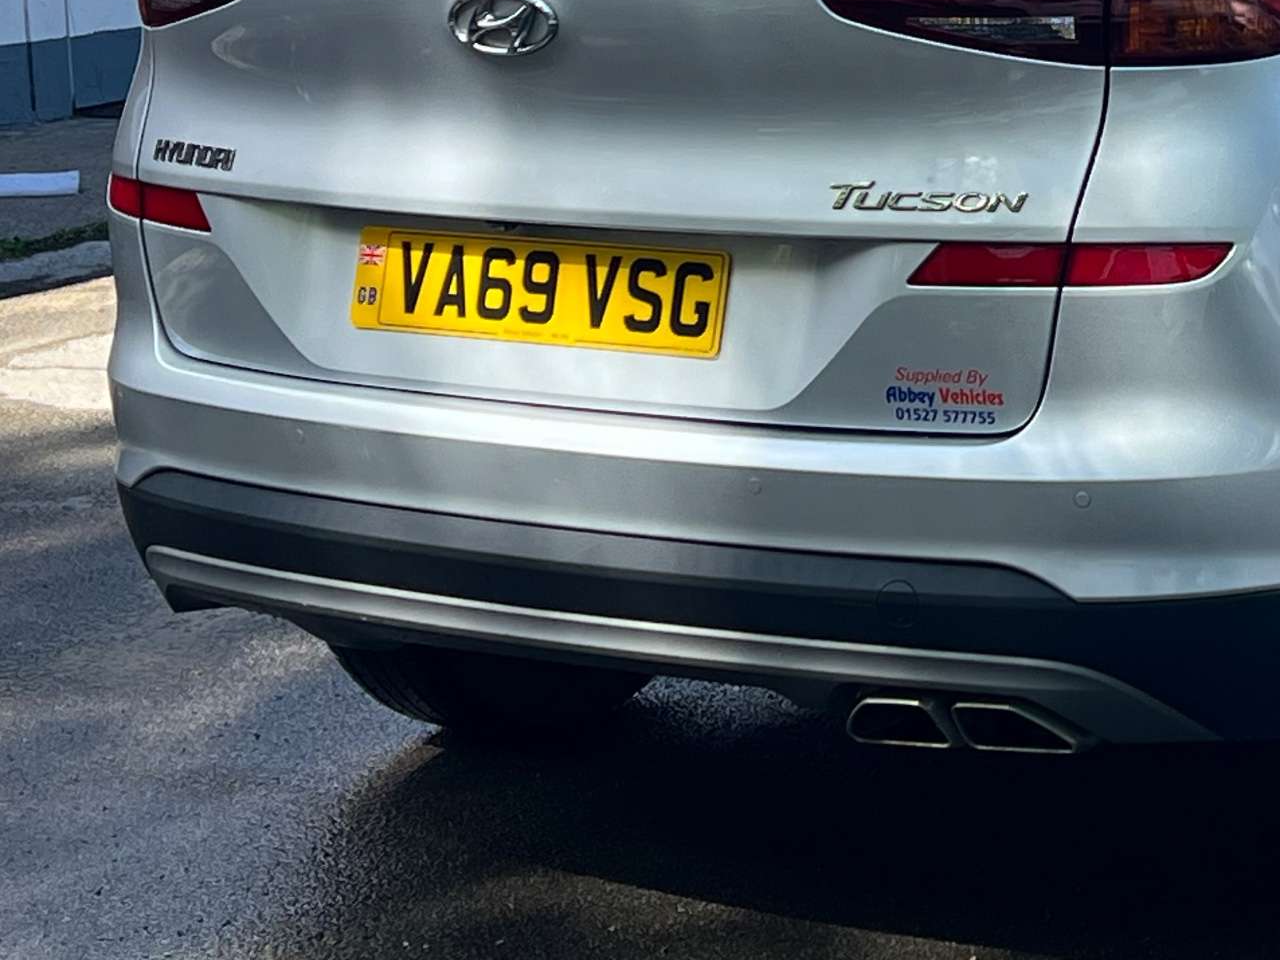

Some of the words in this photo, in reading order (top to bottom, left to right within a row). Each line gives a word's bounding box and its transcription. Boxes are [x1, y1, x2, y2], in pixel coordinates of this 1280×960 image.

[153, 138, 237, 171] HYUNDAI
[357, 286, 377, 305] GB
[402, 240, 560, 325] VA69
[585, 253, 715, 338] VSG
[895, 367, 962, 385] Supplied
[966, 369, 989, 386] By
[886, 386, 935, 407] Abbey
[939, 387, 1004, 406] Vehicles
[895, 407, 938, 422] 01527
[943, 410, 996, 425] 577755
